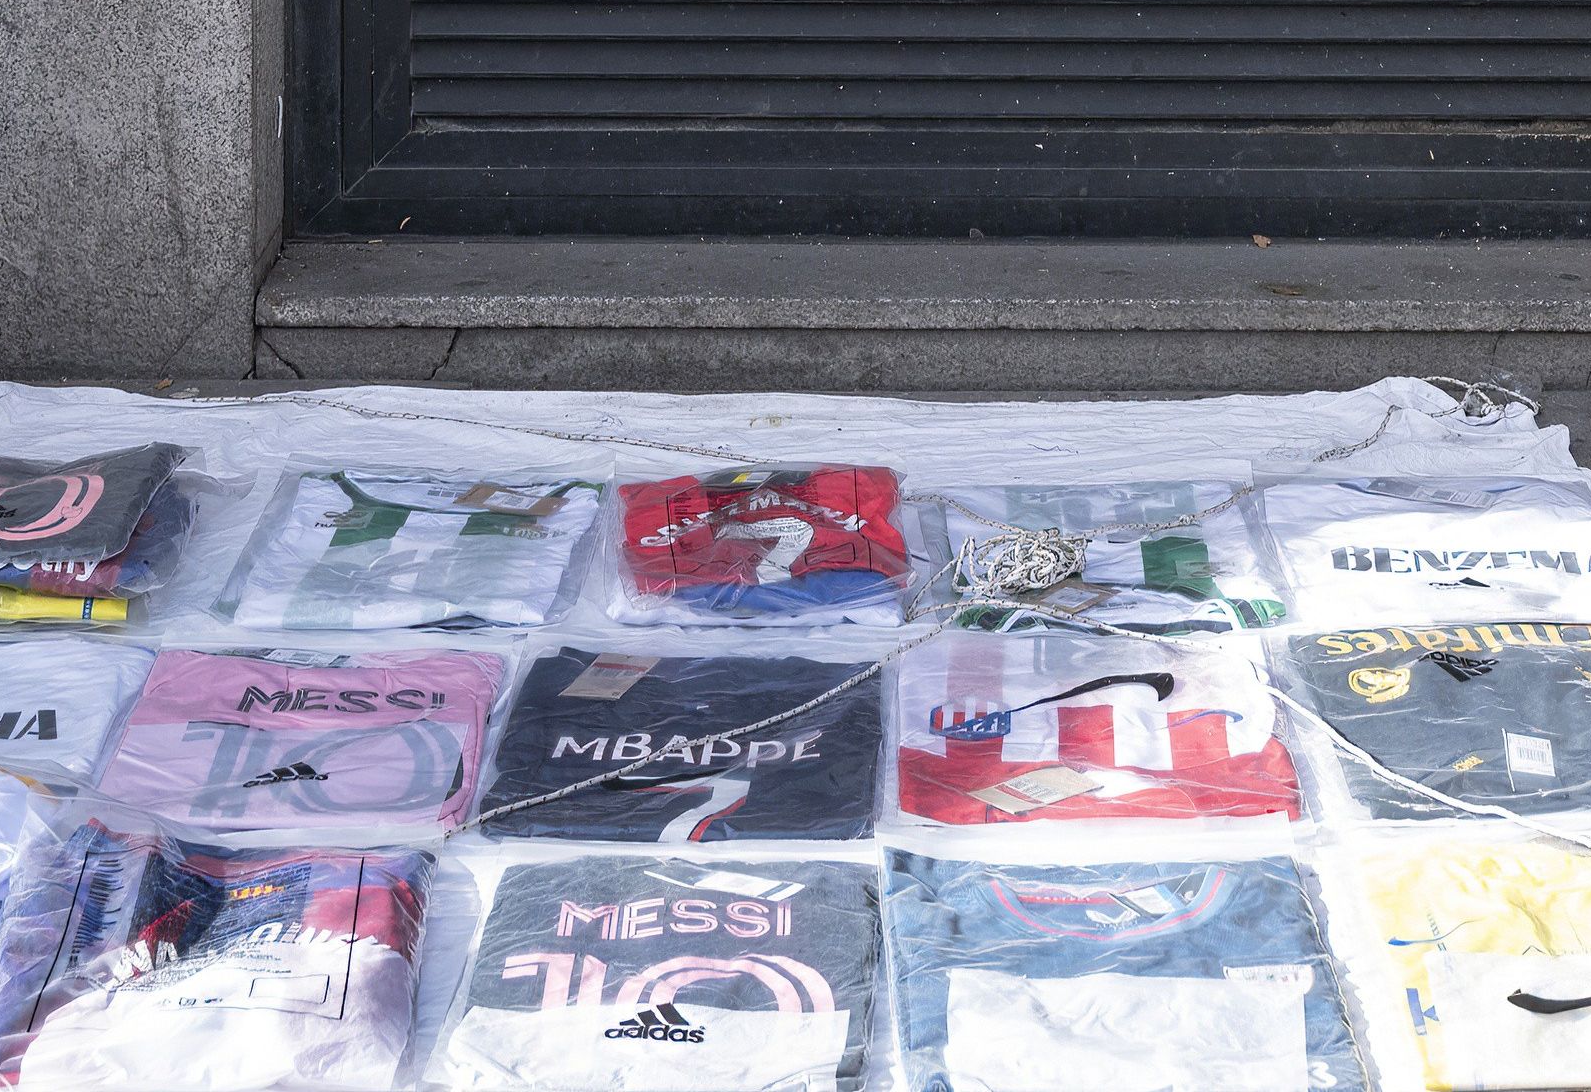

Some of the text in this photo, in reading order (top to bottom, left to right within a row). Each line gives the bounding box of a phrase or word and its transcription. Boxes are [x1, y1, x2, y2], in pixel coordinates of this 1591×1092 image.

[236, 685, 446, 713] MESSI
[181, 719, 463, 819] 10
[619, 776, 751, 842] 7
[557, 897, 792, 941] MESSI
[501, 953, 836, 1013] 10
[604, 1025, 706, 1044] adidas
